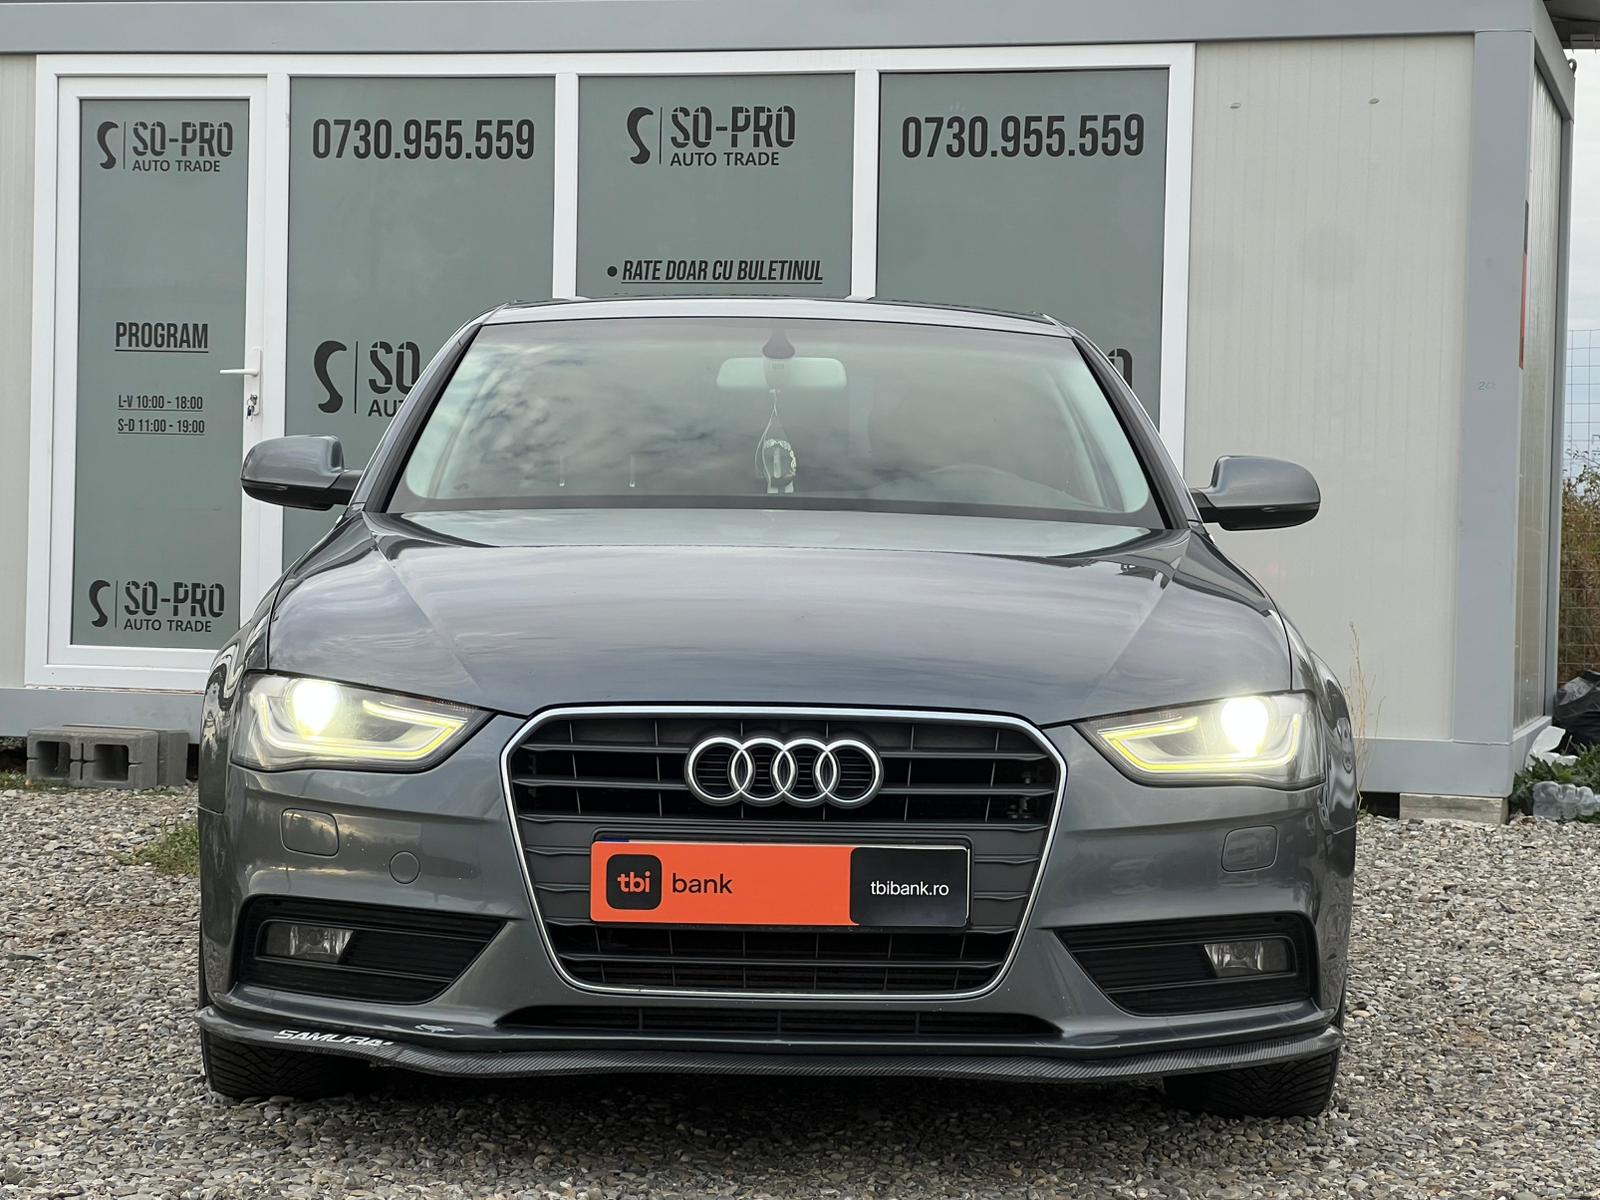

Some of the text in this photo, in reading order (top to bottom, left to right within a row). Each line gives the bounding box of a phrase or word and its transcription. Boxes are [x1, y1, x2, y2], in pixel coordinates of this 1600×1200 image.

[133, 121, 233, 157] SO-PRO
[313, 118, 535, 160] 0730.955.559
[671, 106, 796, 149] SO-PRO
[903, 114, 1144, 158] 0730.955.559
[132, 159, 221, 173] AUTO TRADE
[670, 152, 780, 166] AUTO TRADE
[622, 260, 824, 281] RATE DOAR CU BULETINUL
[116, 322, 209, 349] PROGRAM
[118, 395, 134, 409] L-V
[137, 395, 165, 409] 10:00
[176, 396, 203, 410] 18:00
[117, 418, 135, 432] S-D
[138, 419, 167, 433] 11:00
[177, 420, 205, 434] 19:00
[124, 581, 225, 619] SO-PRO
[124, 618, 212, 633] AUTO TRADE
[617, 870, 733, 895] tbi bank
[870, 879, 950, 897] tbibank.ro
